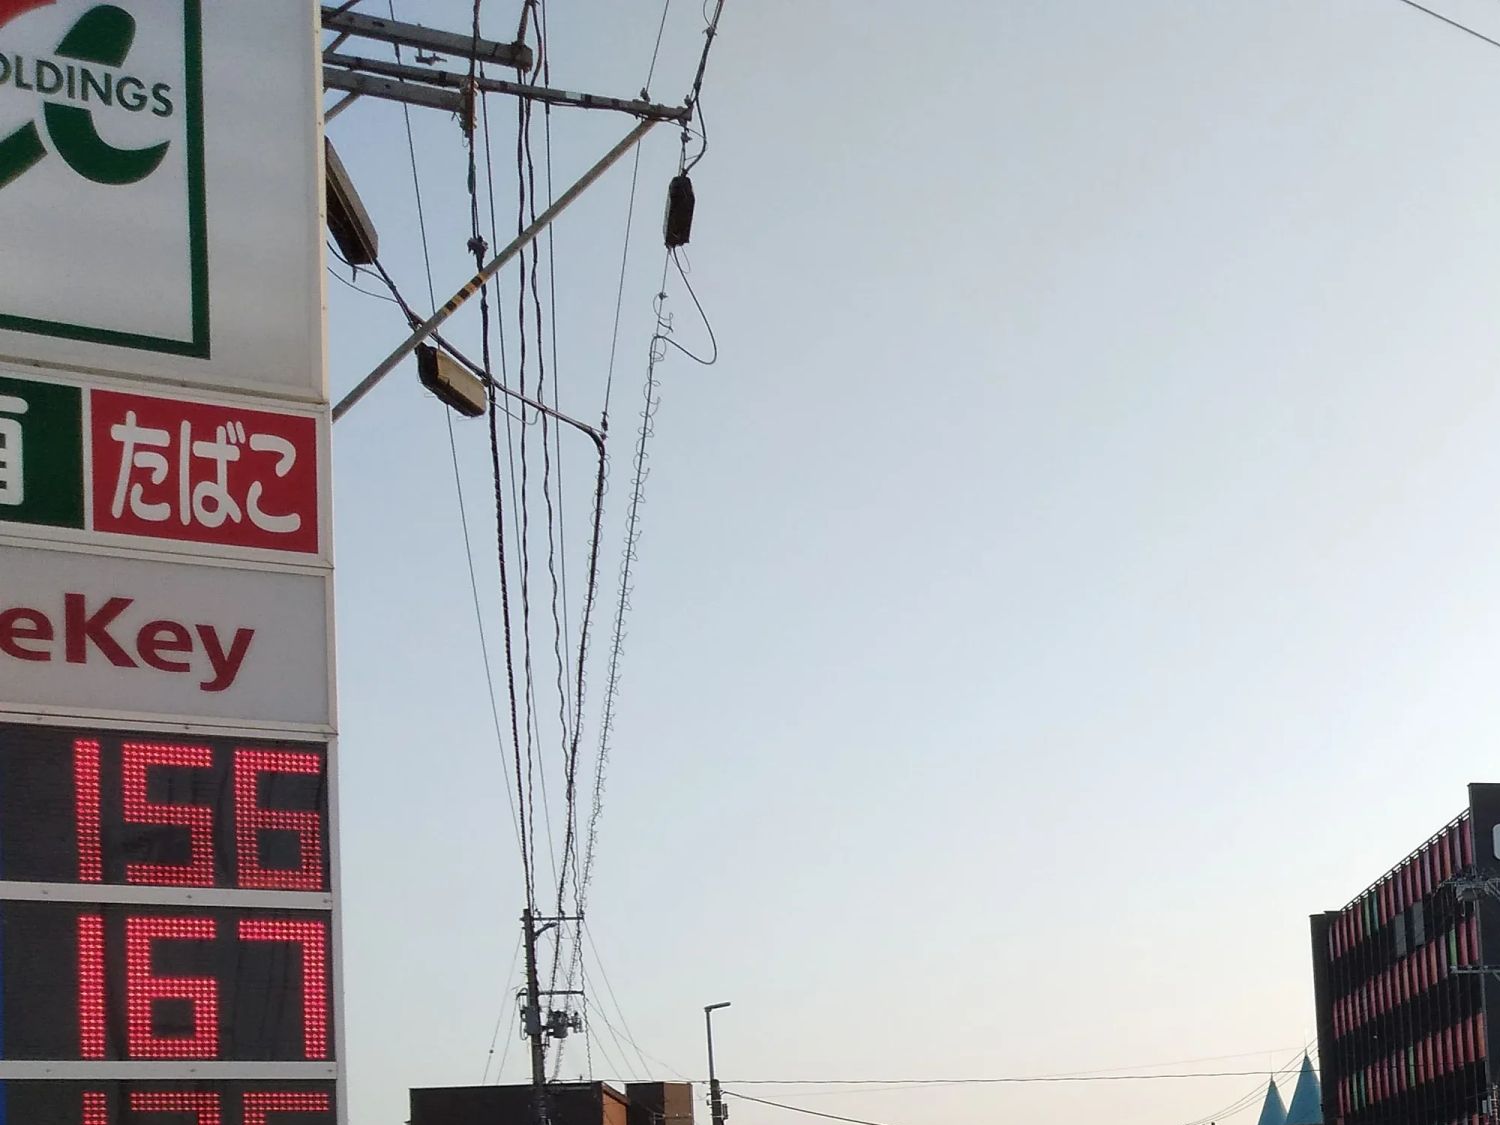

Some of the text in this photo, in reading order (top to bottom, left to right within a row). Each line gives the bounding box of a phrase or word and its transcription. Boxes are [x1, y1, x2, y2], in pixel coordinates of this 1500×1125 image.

[110, 410, 301, 533] たばこ
[0, 592, 255, 692] eKey
[74, 738, 323, 890] 156
[78, 915, 326, 1059] 167
